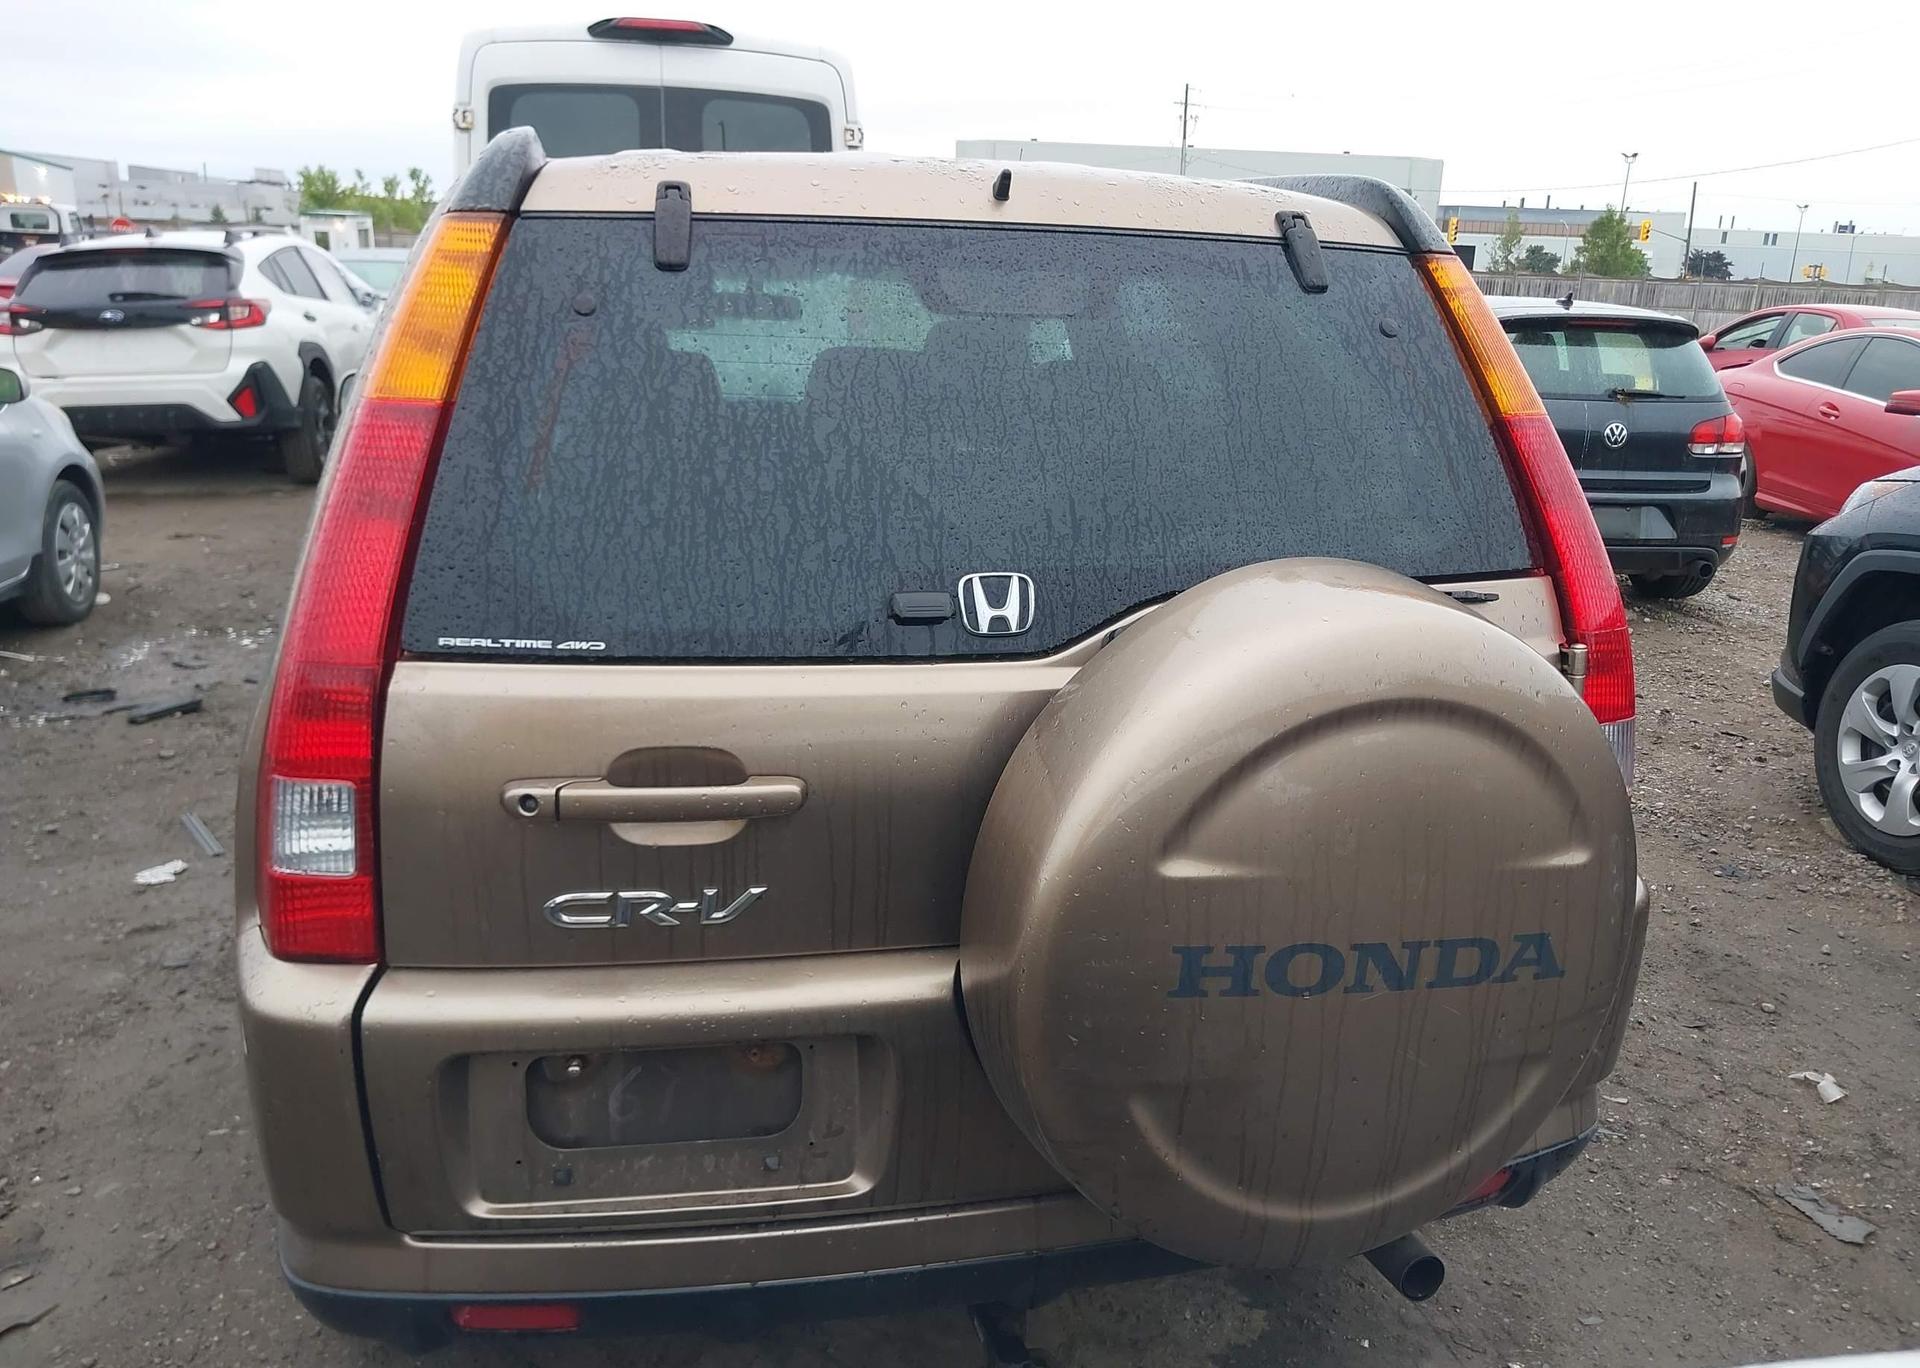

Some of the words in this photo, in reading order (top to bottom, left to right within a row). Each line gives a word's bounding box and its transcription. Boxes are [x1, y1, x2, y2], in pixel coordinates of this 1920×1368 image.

[437, 637, 553, 649] REALTIME
[556, 640, 606, 650] 4WD
[543, 886, 768, 929] CR-V
[1167, 932, 1566, 998] HONDA
